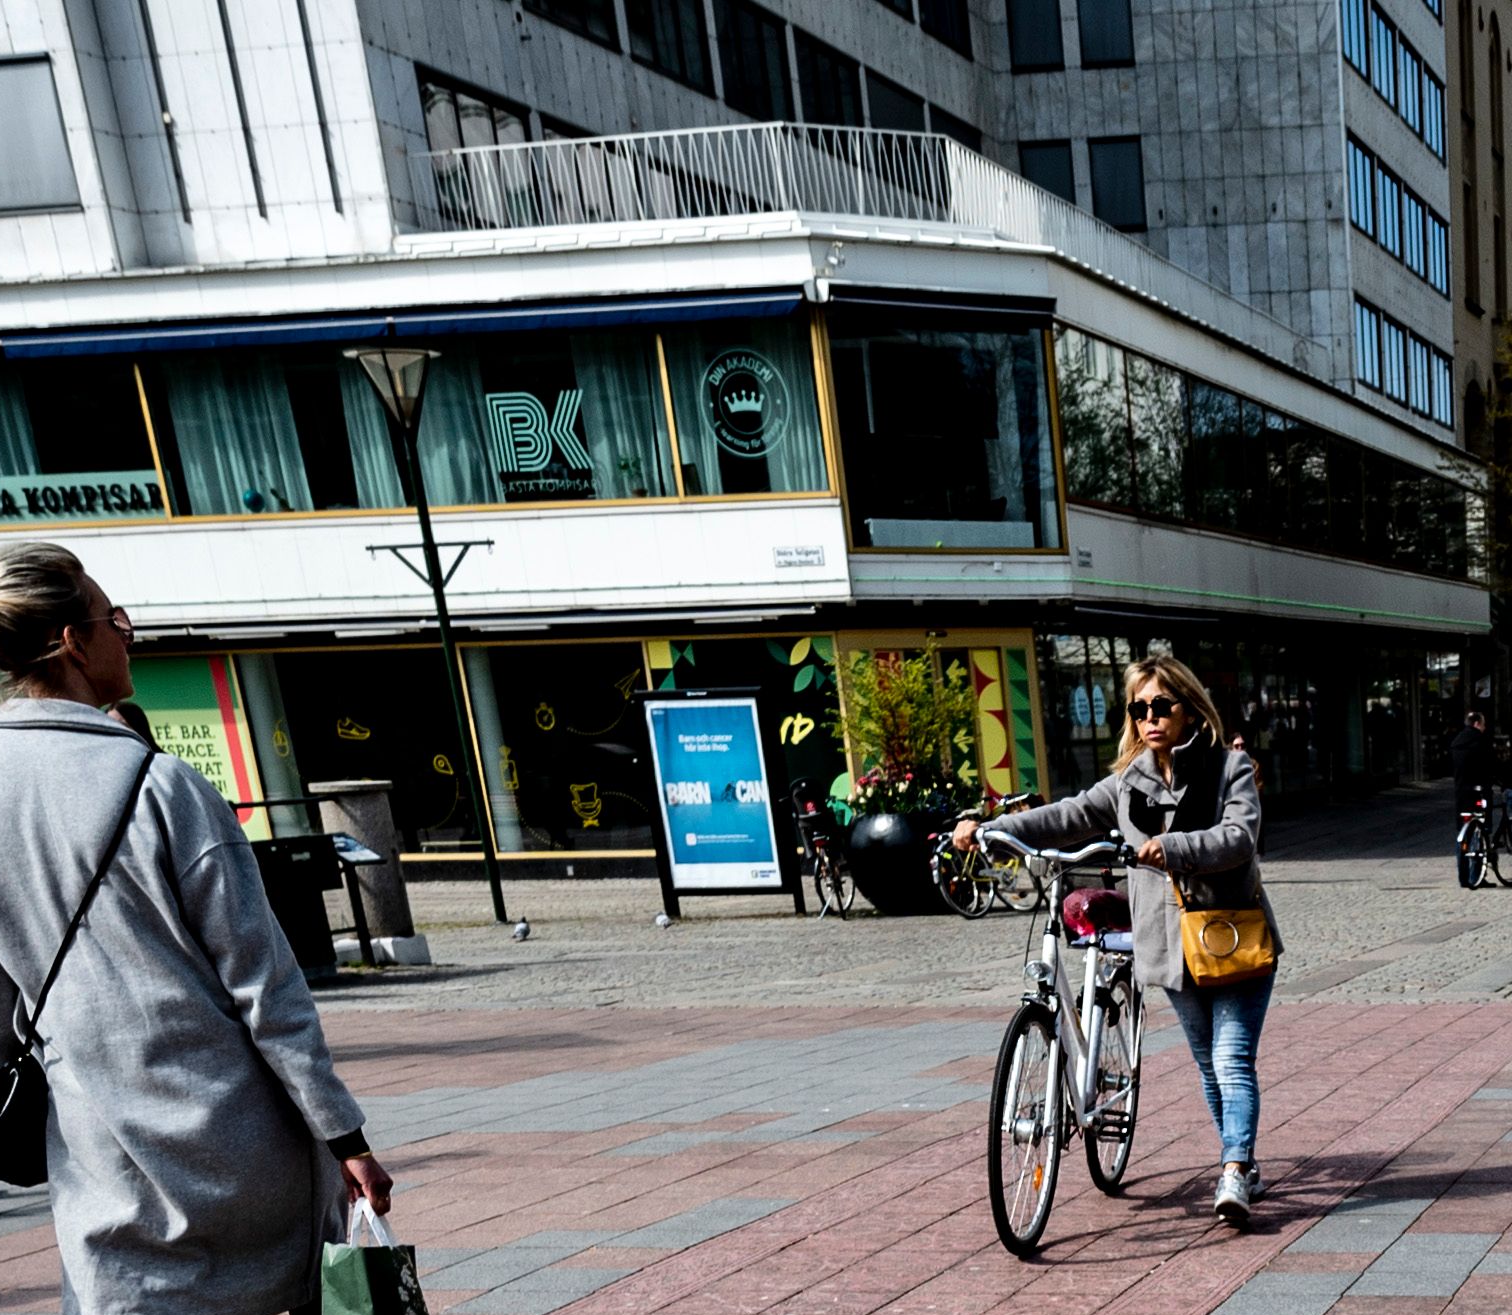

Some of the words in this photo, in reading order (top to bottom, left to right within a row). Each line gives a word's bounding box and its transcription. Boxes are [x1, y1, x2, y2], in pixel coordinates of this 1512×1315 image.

[486, 388, 595, 472] BK
[21, 482, 166, 517] KOMPISAR
[154, 723, 178, 740] FÉ.
[180, 725, 216, 740] BAR.
[165, 743, 221, 759] SPACE.
[666, 781, 713, 805] BARN
